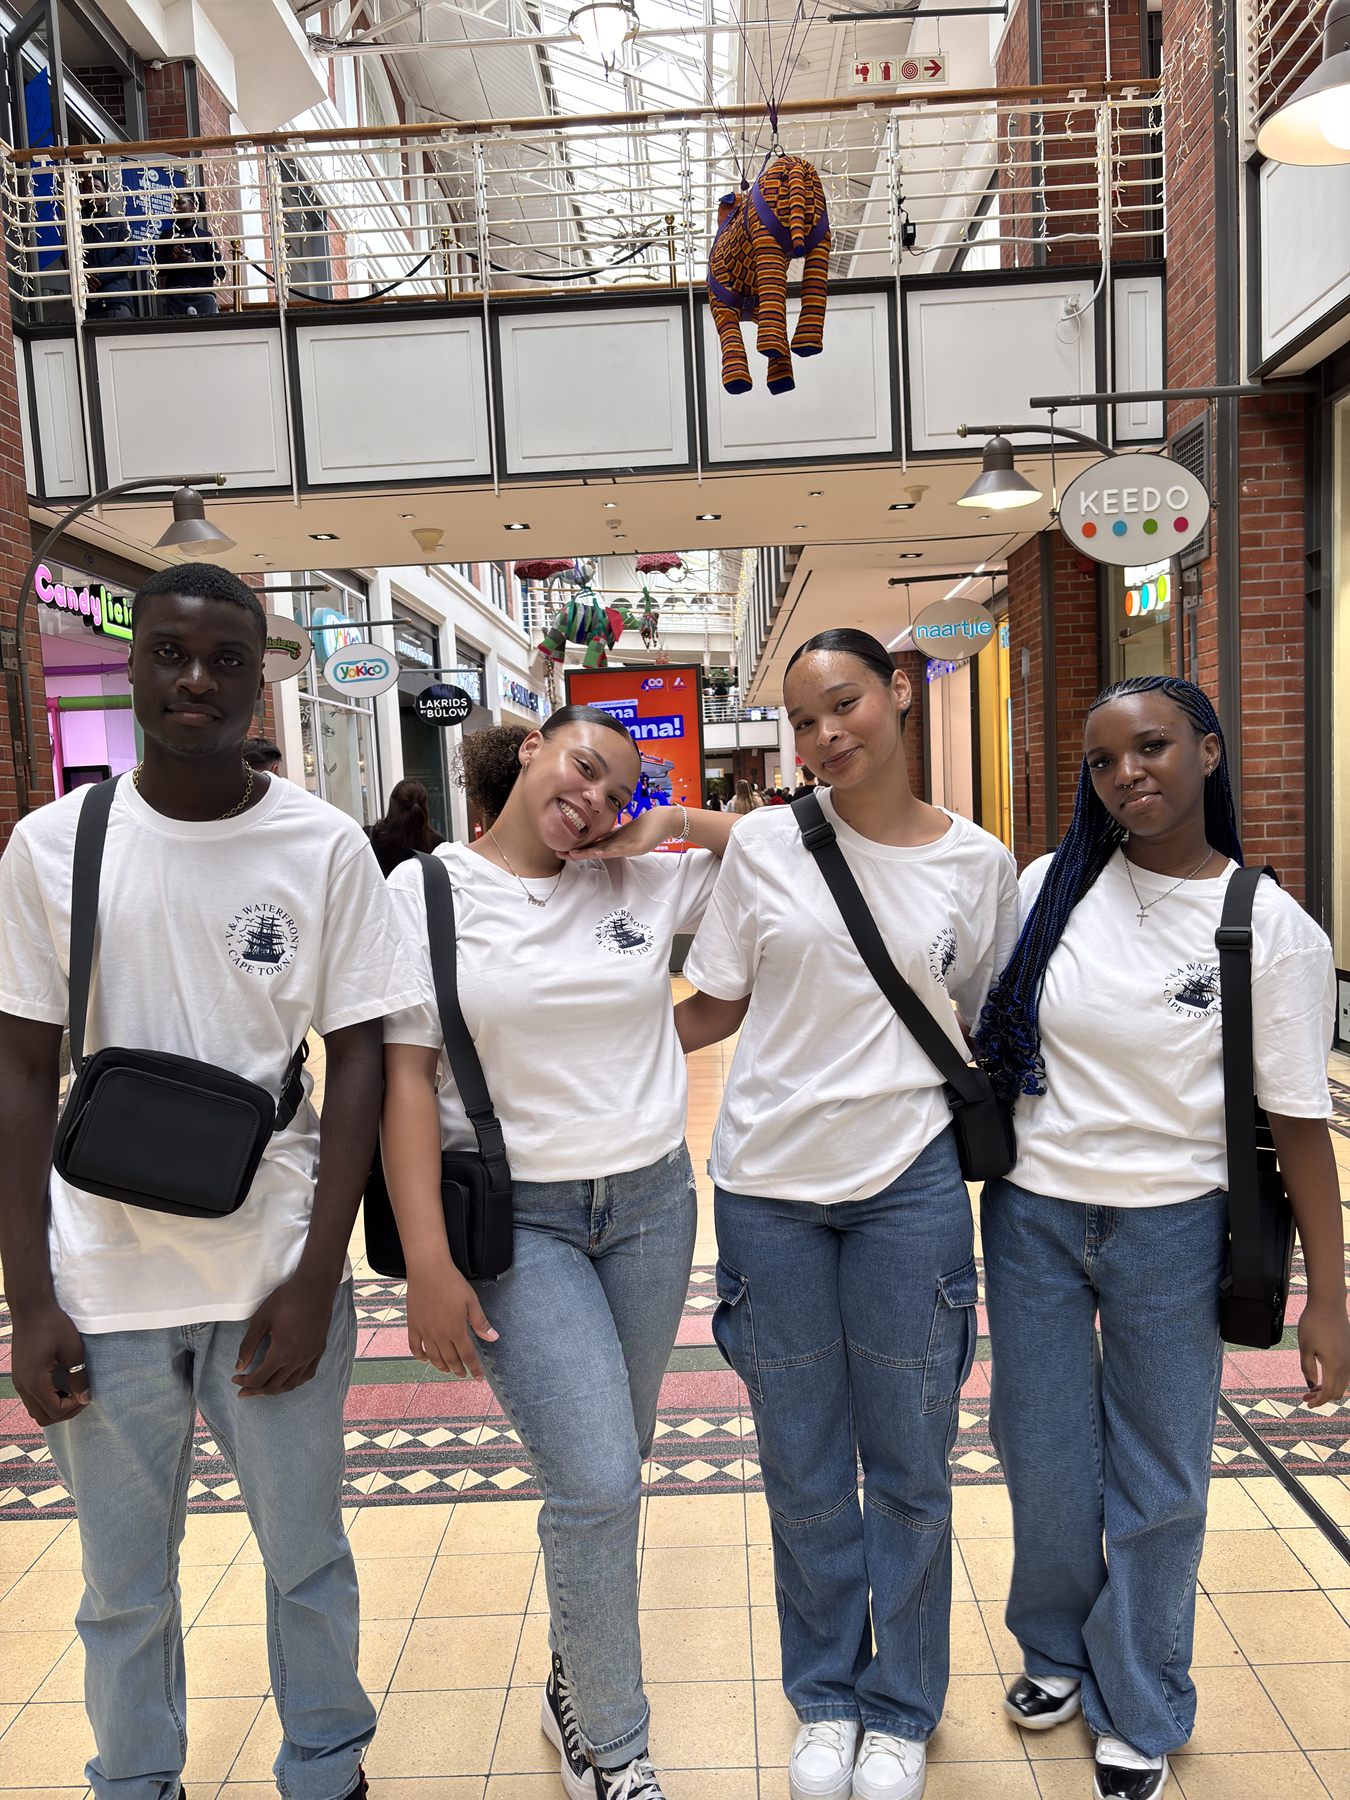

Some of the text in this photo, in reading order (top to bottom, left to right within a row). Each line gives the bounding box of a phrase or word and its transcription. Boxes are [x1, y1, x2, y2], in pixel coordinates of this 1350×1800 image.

[1080, 485, 1189, 516] KEEDO
[915, 616, 992, 639] naartjie
[419, 698, 468, 709] LAKRIDS
[426, 706, 469, 718] BÜLOW
[225, 903, 299, 951] V&A WATERFRONT
[608, 935, 655, 956] CAPE TOWN
[228, 949, 291, 976] CAPE TOWN
[1163, 989, 1219, 1019] CAPE TOWN
